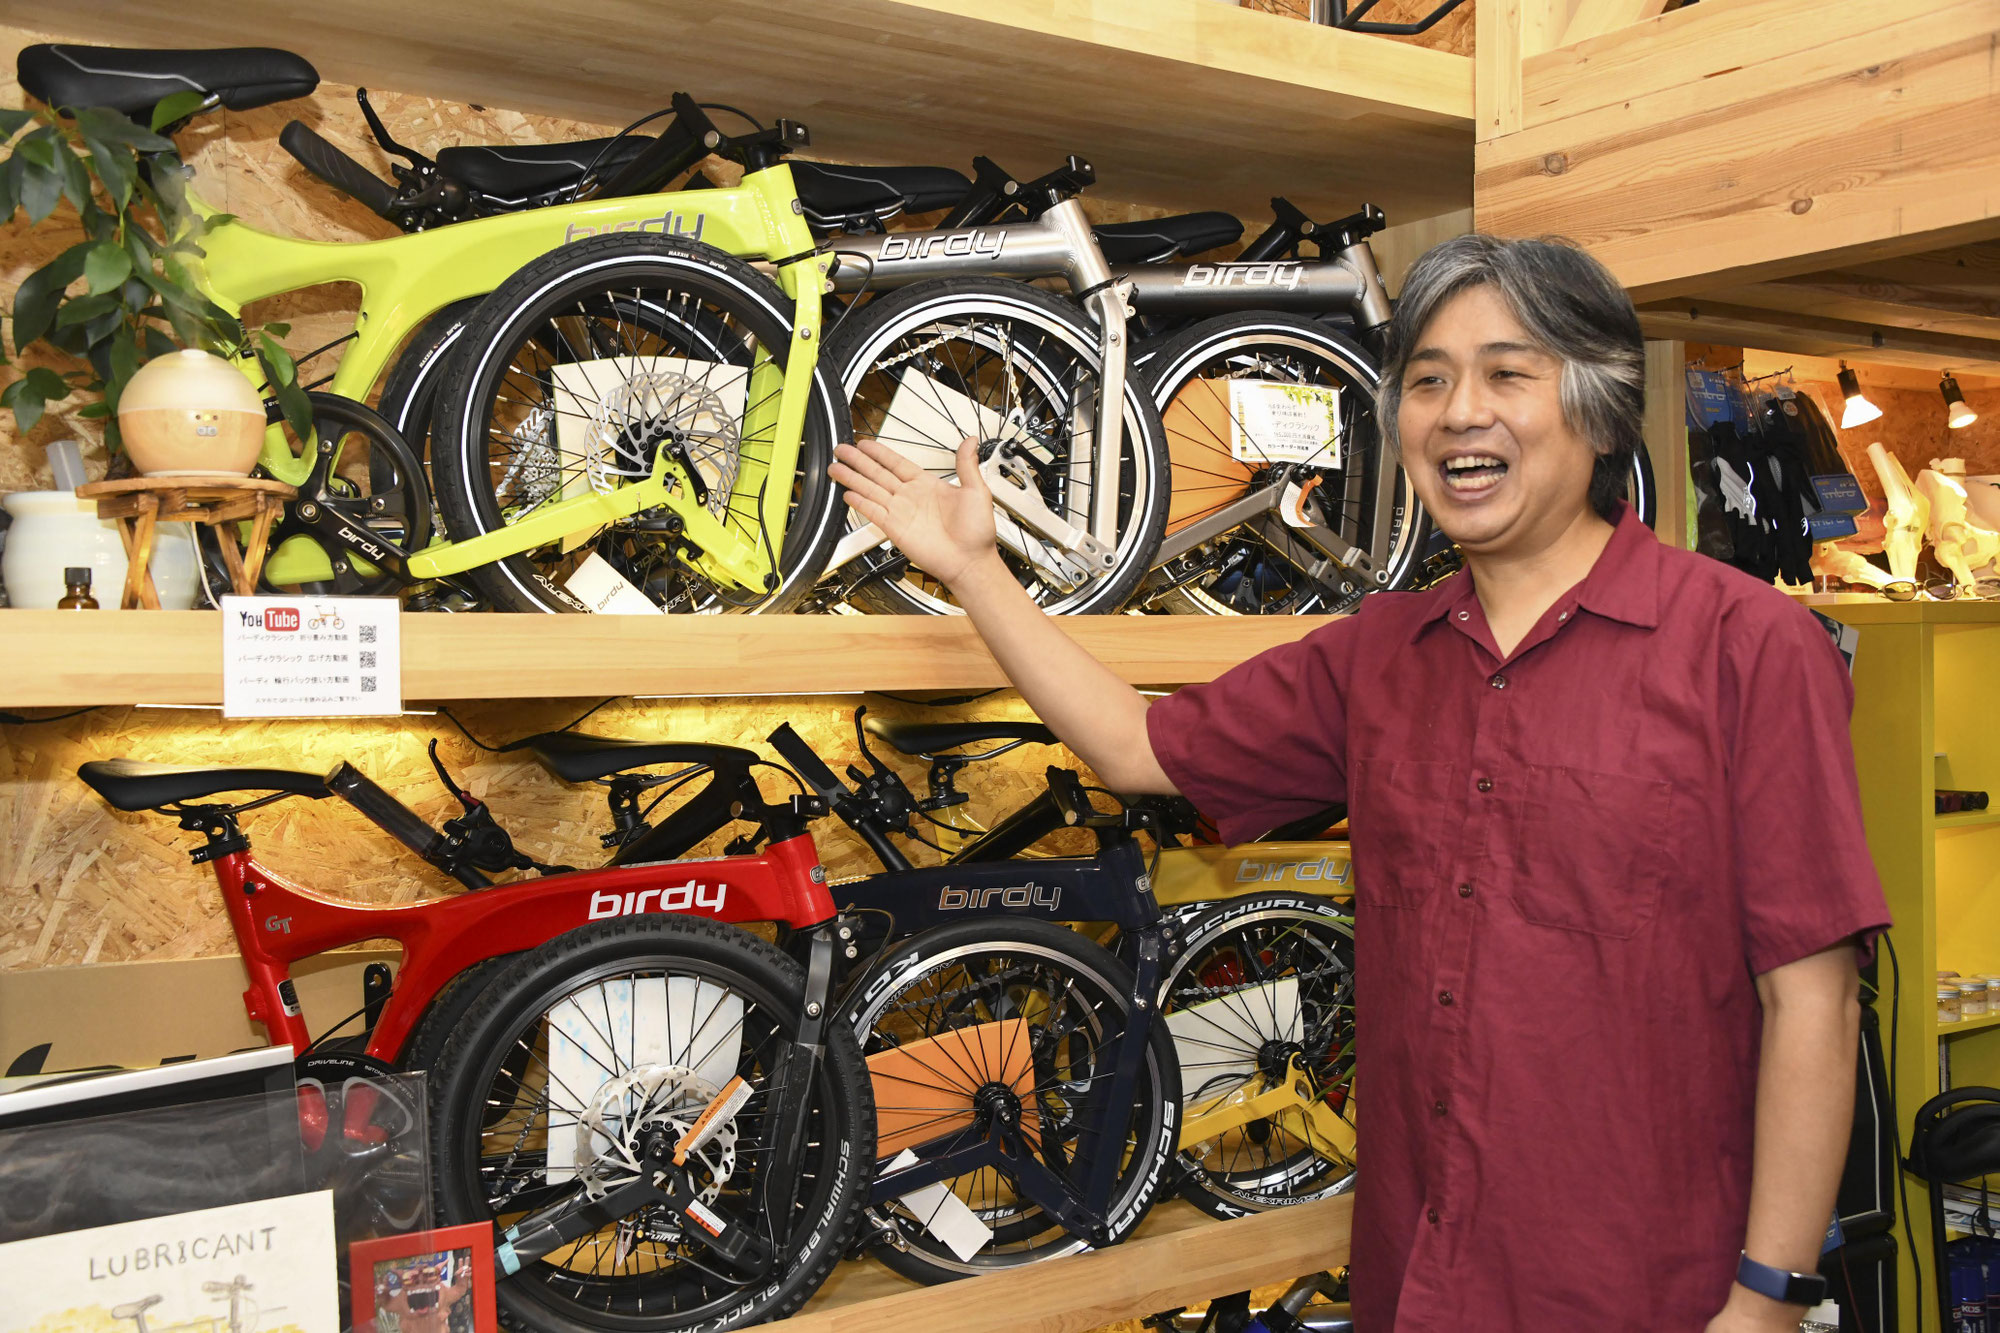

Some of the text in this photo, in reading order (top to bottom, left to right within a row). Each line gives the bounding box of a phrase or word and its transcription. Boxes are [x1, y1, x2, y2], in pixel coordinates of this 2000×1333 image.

[878, 229, 1007, 262] birdy
[709, 260, 728, 271] birdy
[1183, 262, 1304, 291] birdy
[337, 526, 386, 560] birdy
[532, 573, 596, 614] ALEXR
[597, 581, 624, 610] birdy
[1235, 856, 1353, 886] birdy
[588, 880, 727, 920] birdy
[938, 882, 1062, 911] birdy
[265, 915, 292, 934] GT
[1185, 899, 1342, 947] SCHWALB
[307, 1059, 356, 1067] DRIVELINE
[800, 1138, 850, 1264] SCHWALBE
[1231, 1189, 1320, 1206] ALEXRIMS
[89, 1226, 276, 1281] LUBRICANT
[713, 1281, 780, 1330] BLACK
